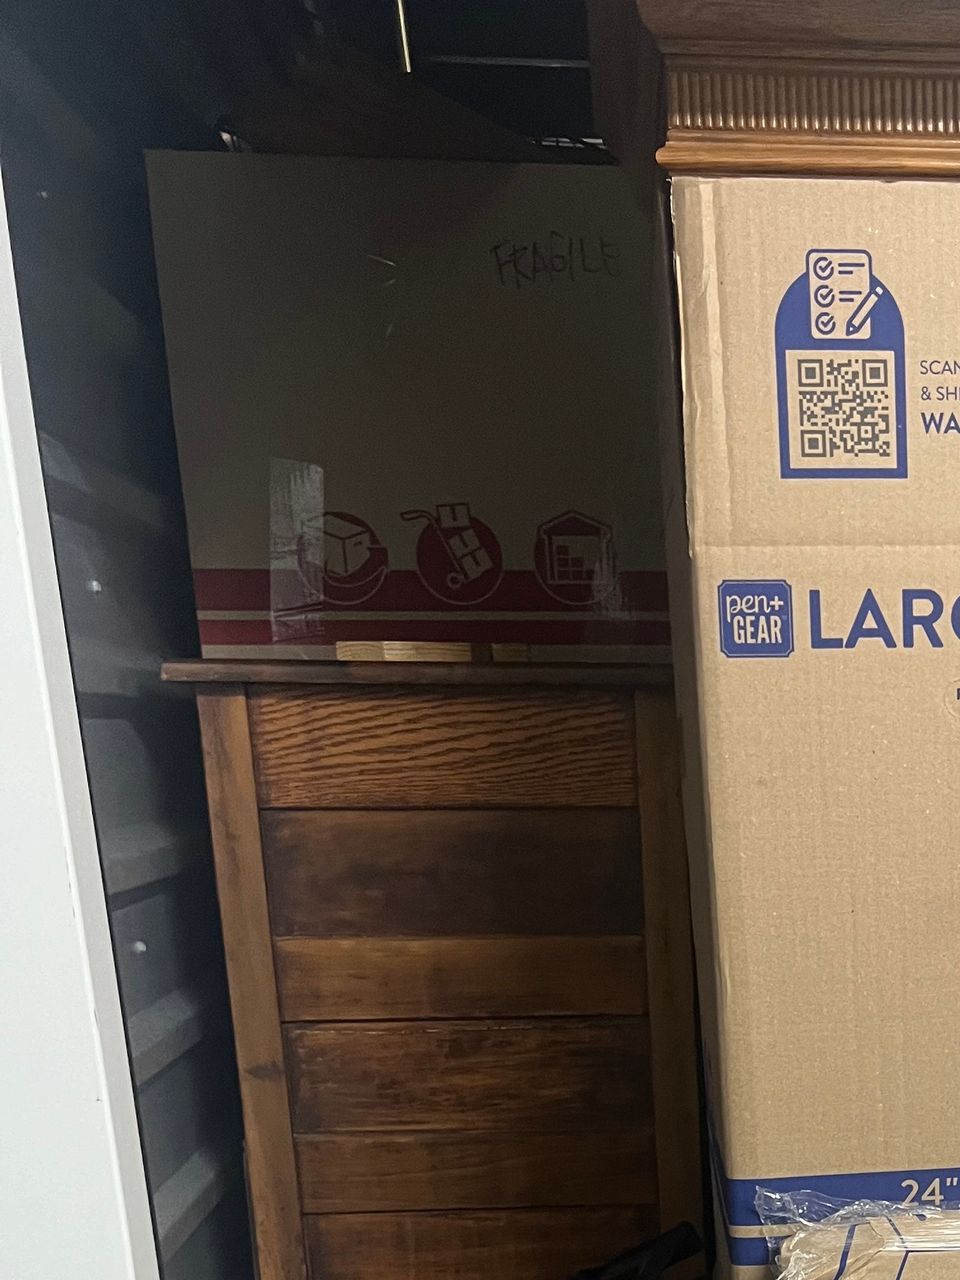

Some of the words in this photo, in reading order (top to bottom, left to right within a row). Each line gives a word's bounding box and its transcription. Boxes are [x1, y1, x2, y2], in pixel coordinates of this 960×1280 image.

[491, 231, 622, 289] FRAGILE
[920, 386, 931, 401] &
[733, 615, 782, 645] GEAR
[901, 1177, 958, 1207] 24"
